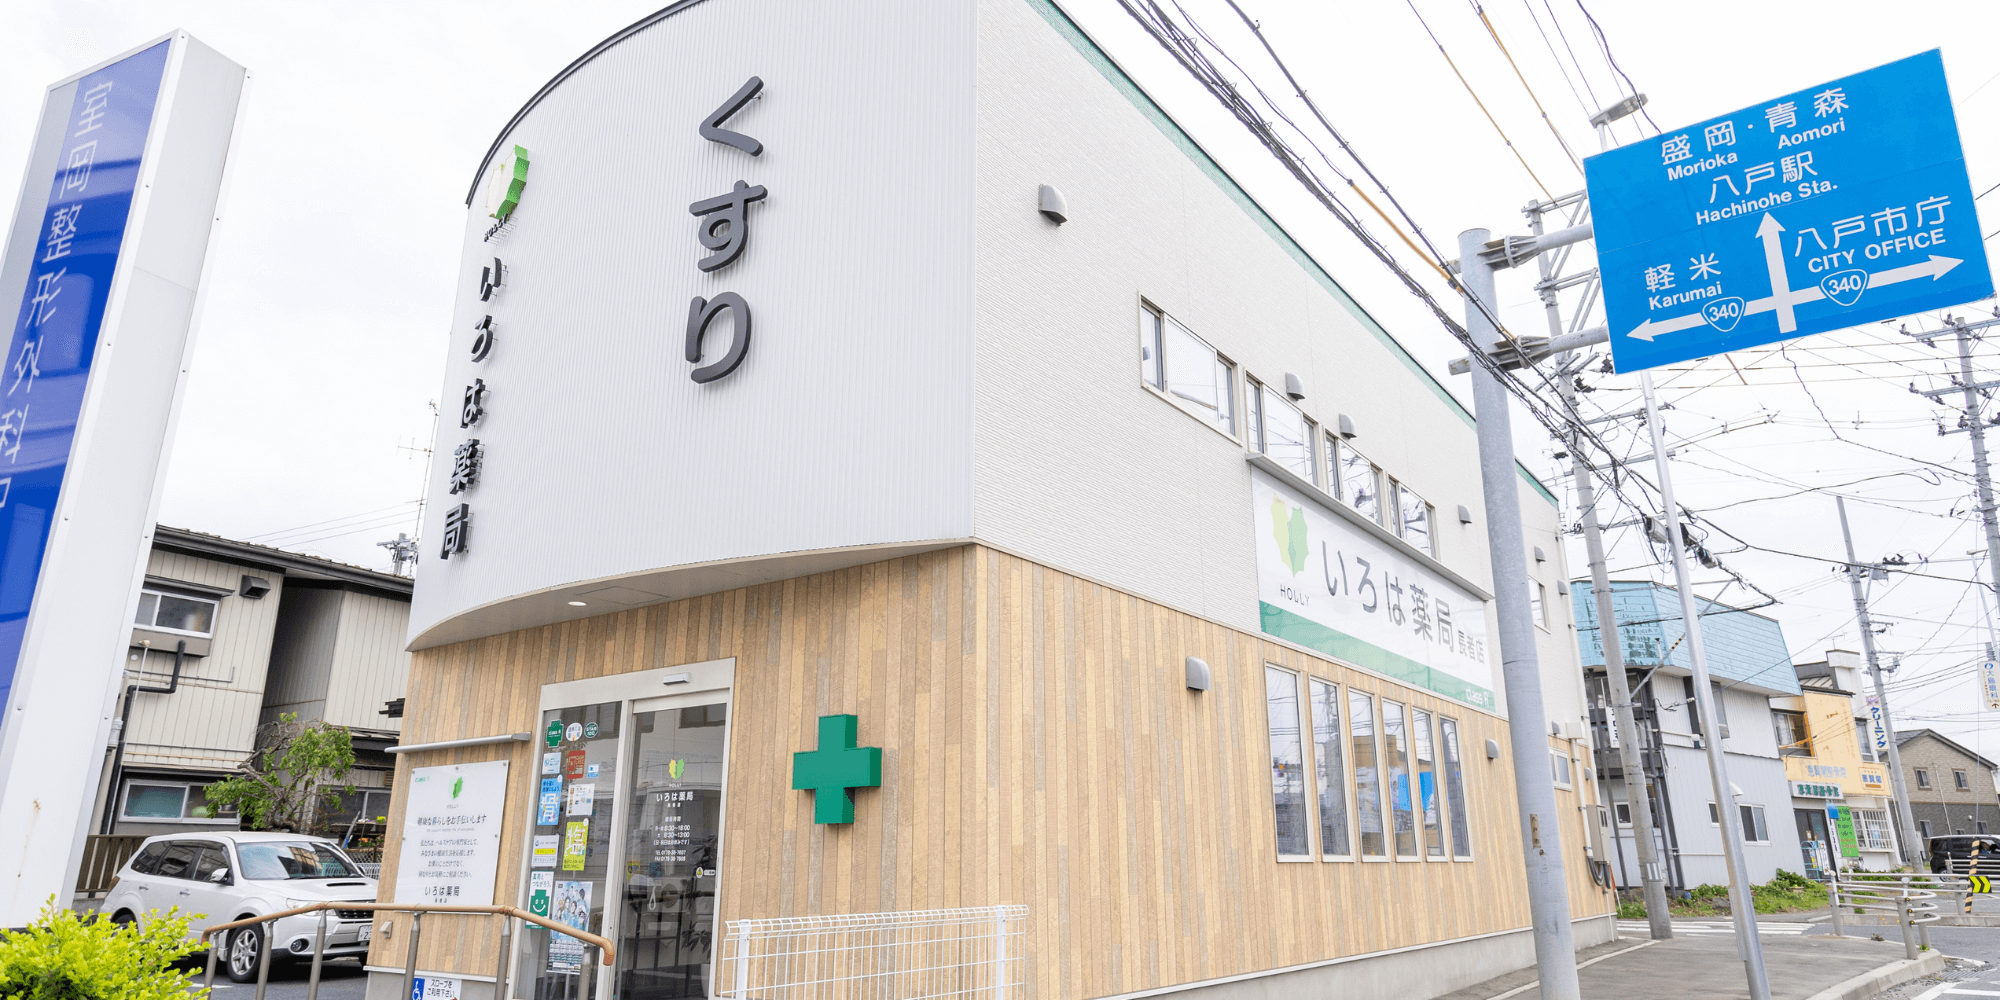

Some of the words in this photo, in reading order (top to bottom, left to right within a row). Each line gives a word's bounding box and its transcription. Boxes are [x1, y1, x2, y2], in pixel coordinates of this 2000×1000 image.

[1667, 151, 1738, 181] Morioka
[1778, 117, 1846, 149] Aomori
[1709, 150, 1818, 204] 八戸駅
[1696, 191, 1793, 226] Hachinohe
[1797, 179, 1838, 199] Sta.
[685, 76, 768, 385] くすり
[1795, 195, 1951, 257] 八戸市庁
[1808, 249, 1856, 273] CITY
[1864, 228, 1946, 260] OFFICE
[1644, 252, 1721, 293] 軽米
[1828, 275, 1862, 295] 340
[0, 80, 113, 509] 室岡整形外科
[1649, 281, 1722, 311] Karumai
[1709, 302, 1740, 322] 340
[440, 256, 502, 560] いろは薬局
[1280, 584, 1310, 608] HOLLY
[1322, 540, 1455, 653] いろは薬局
[1457, 629, 1485, 665] 長者店
[1870, 706, 1888, 749] クリーニング
[656, 791, 694, 802] いろは薬局
[425, 885, 460, 897] いろは薬局
[427, 988, 455, 998] ご利用下さい
[431, 979, 452, 988] スロープを
